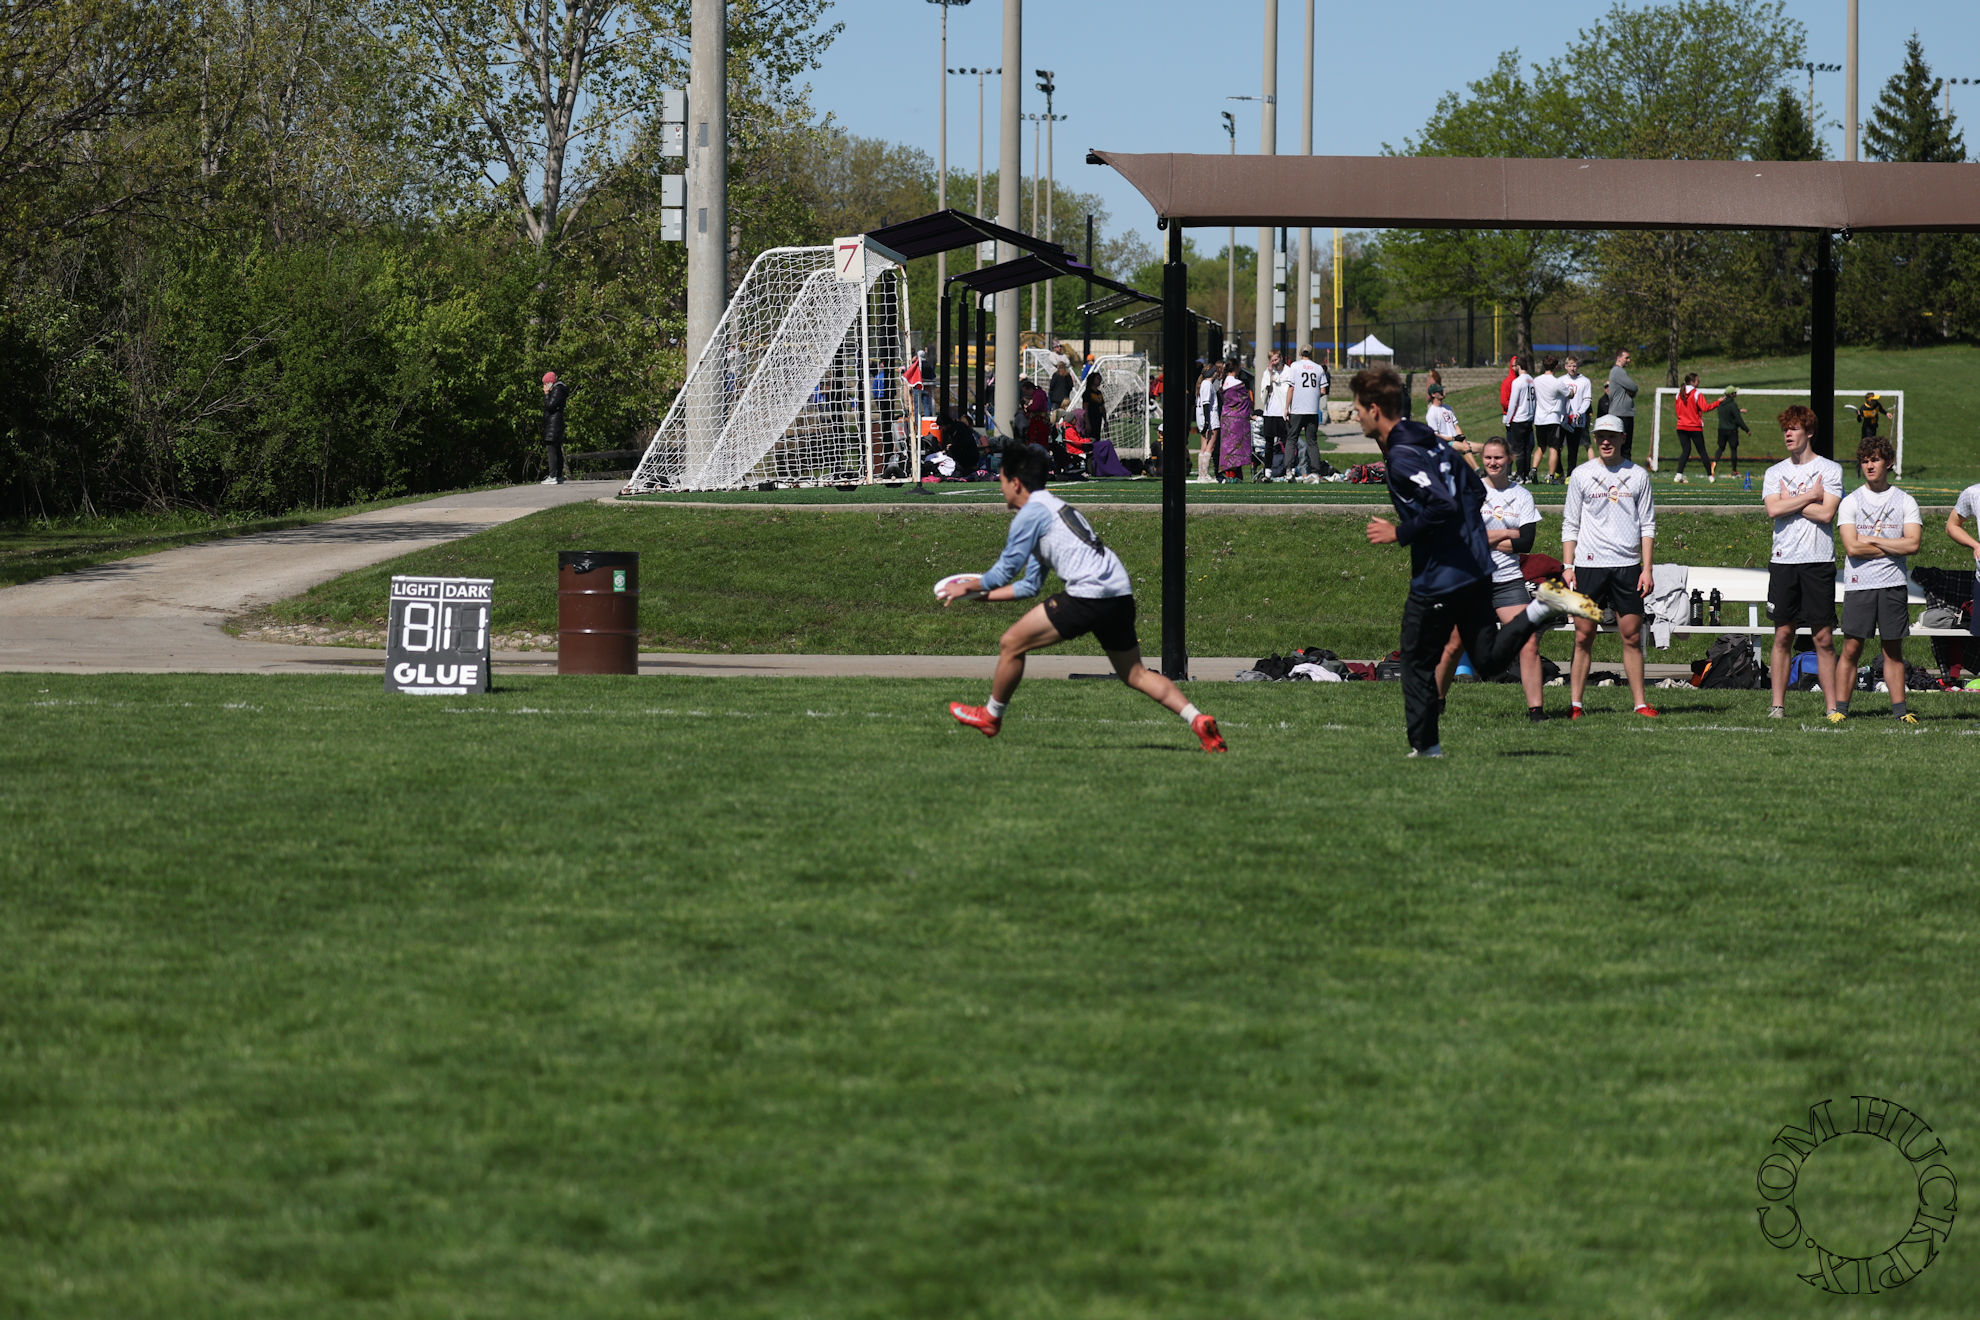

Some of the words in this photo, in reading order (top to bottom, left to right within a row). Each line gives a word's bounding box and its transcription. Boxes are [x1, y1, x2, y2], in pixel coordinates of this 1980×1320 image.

[838, 244, 859, 273] 7
[1301, 371, 1317, 388] 26
[394, 583, 438, 596] LIGHT
[445, 585, 488, 598] DARK
[402, 602, 435, 652] 8
[393, 662, 478, 685] GLUE
